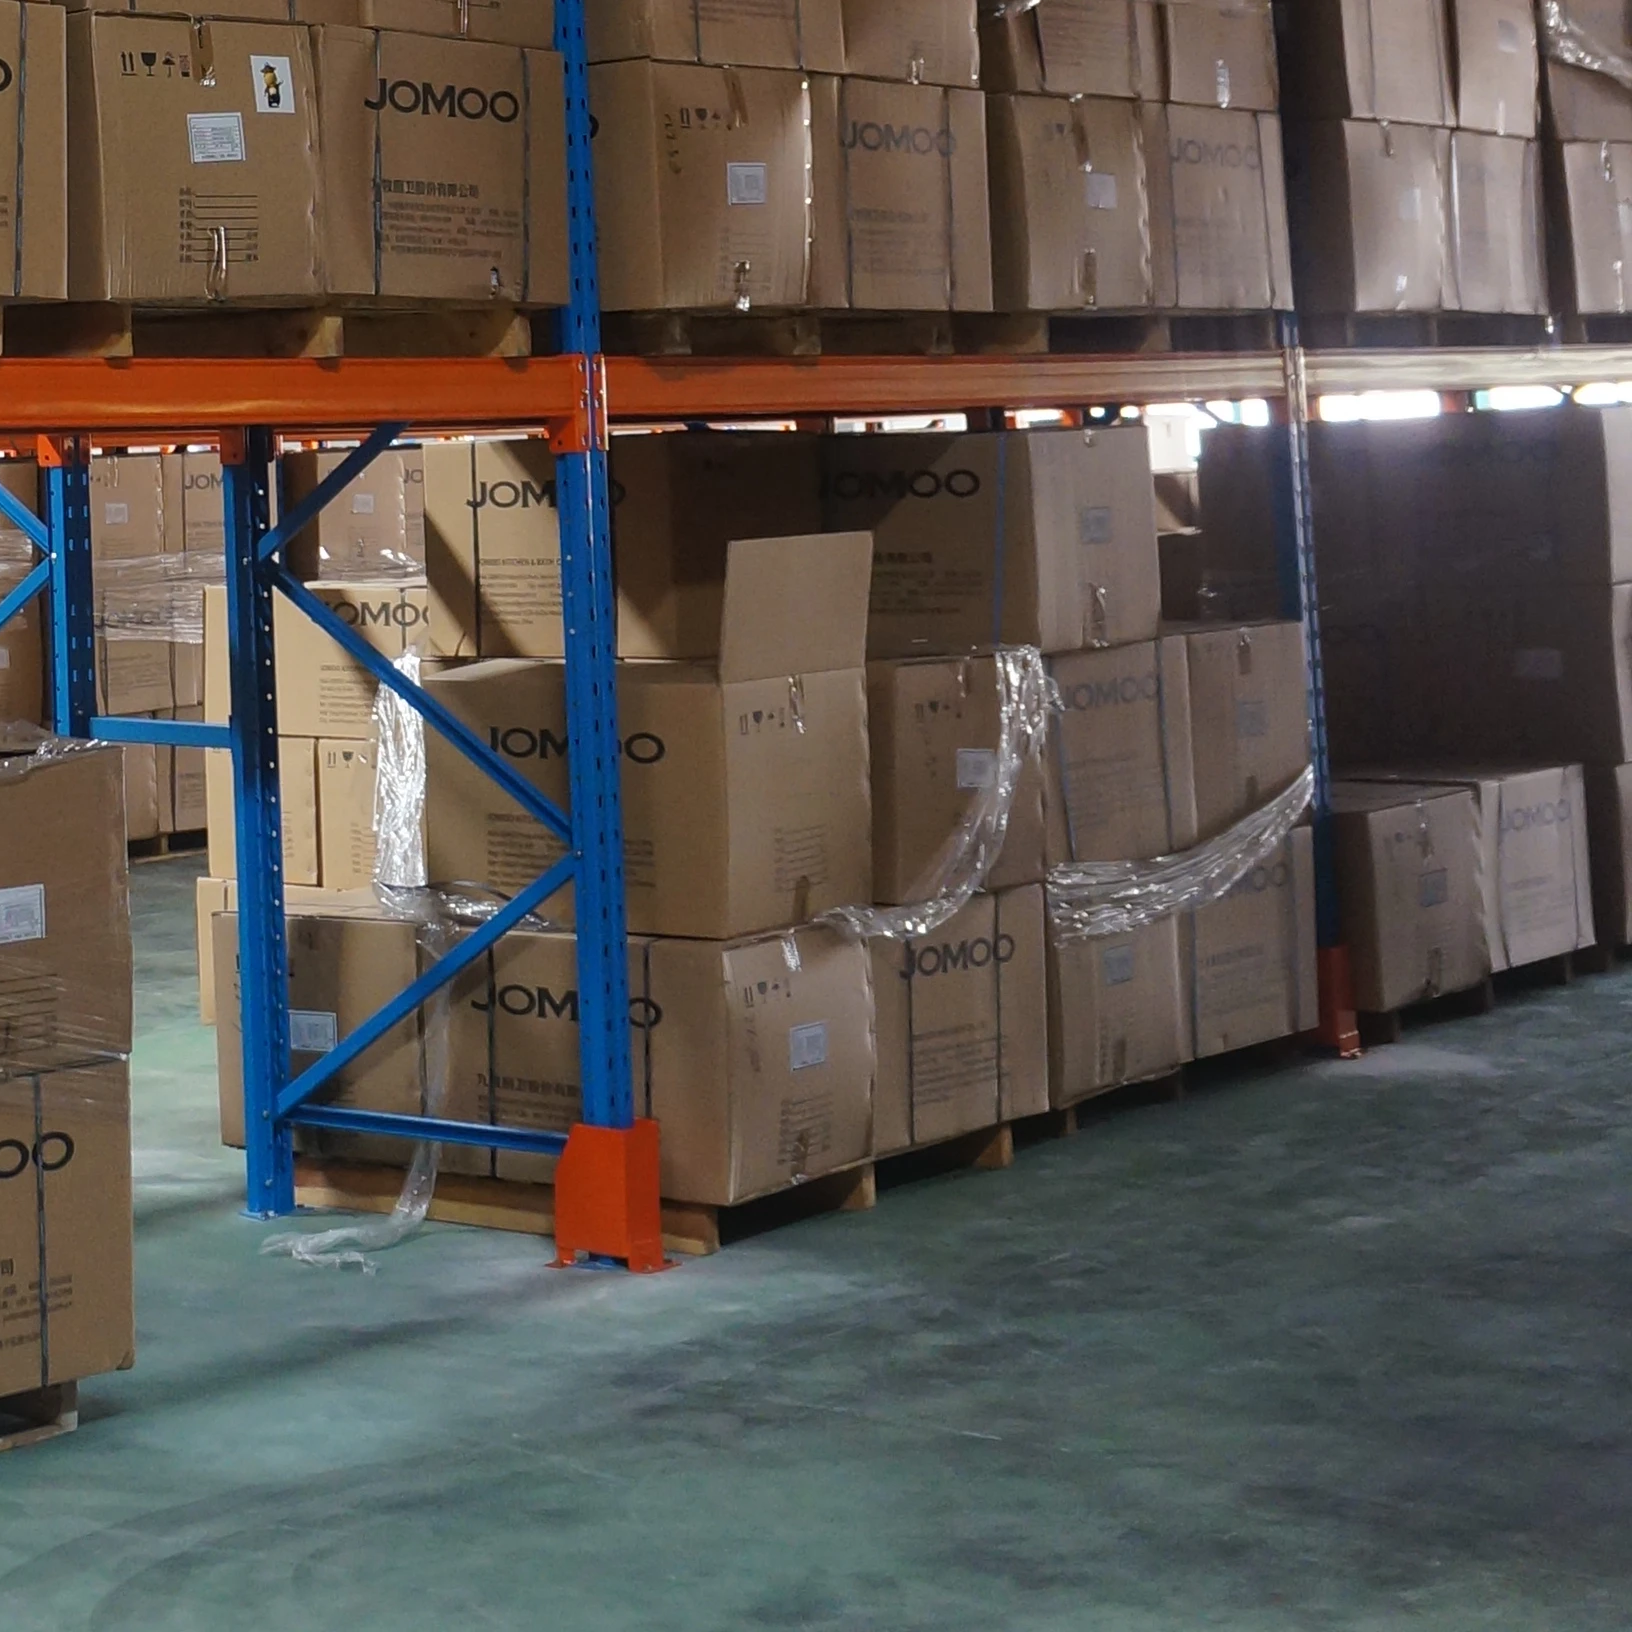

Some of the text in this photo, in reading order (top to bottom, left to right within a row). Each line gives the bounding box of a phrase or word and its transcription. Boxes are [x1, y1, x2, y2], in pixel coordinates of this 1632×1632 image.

[364, 77, 519, 124] JOMOO
[841, 121, 957, 157] JOMOO
[373, 179, 480, 200] 牧厨卫股份有限公司
[900, 934, 1016, 978] JOMOO
[471, 984, 663, 1029] JOMO
